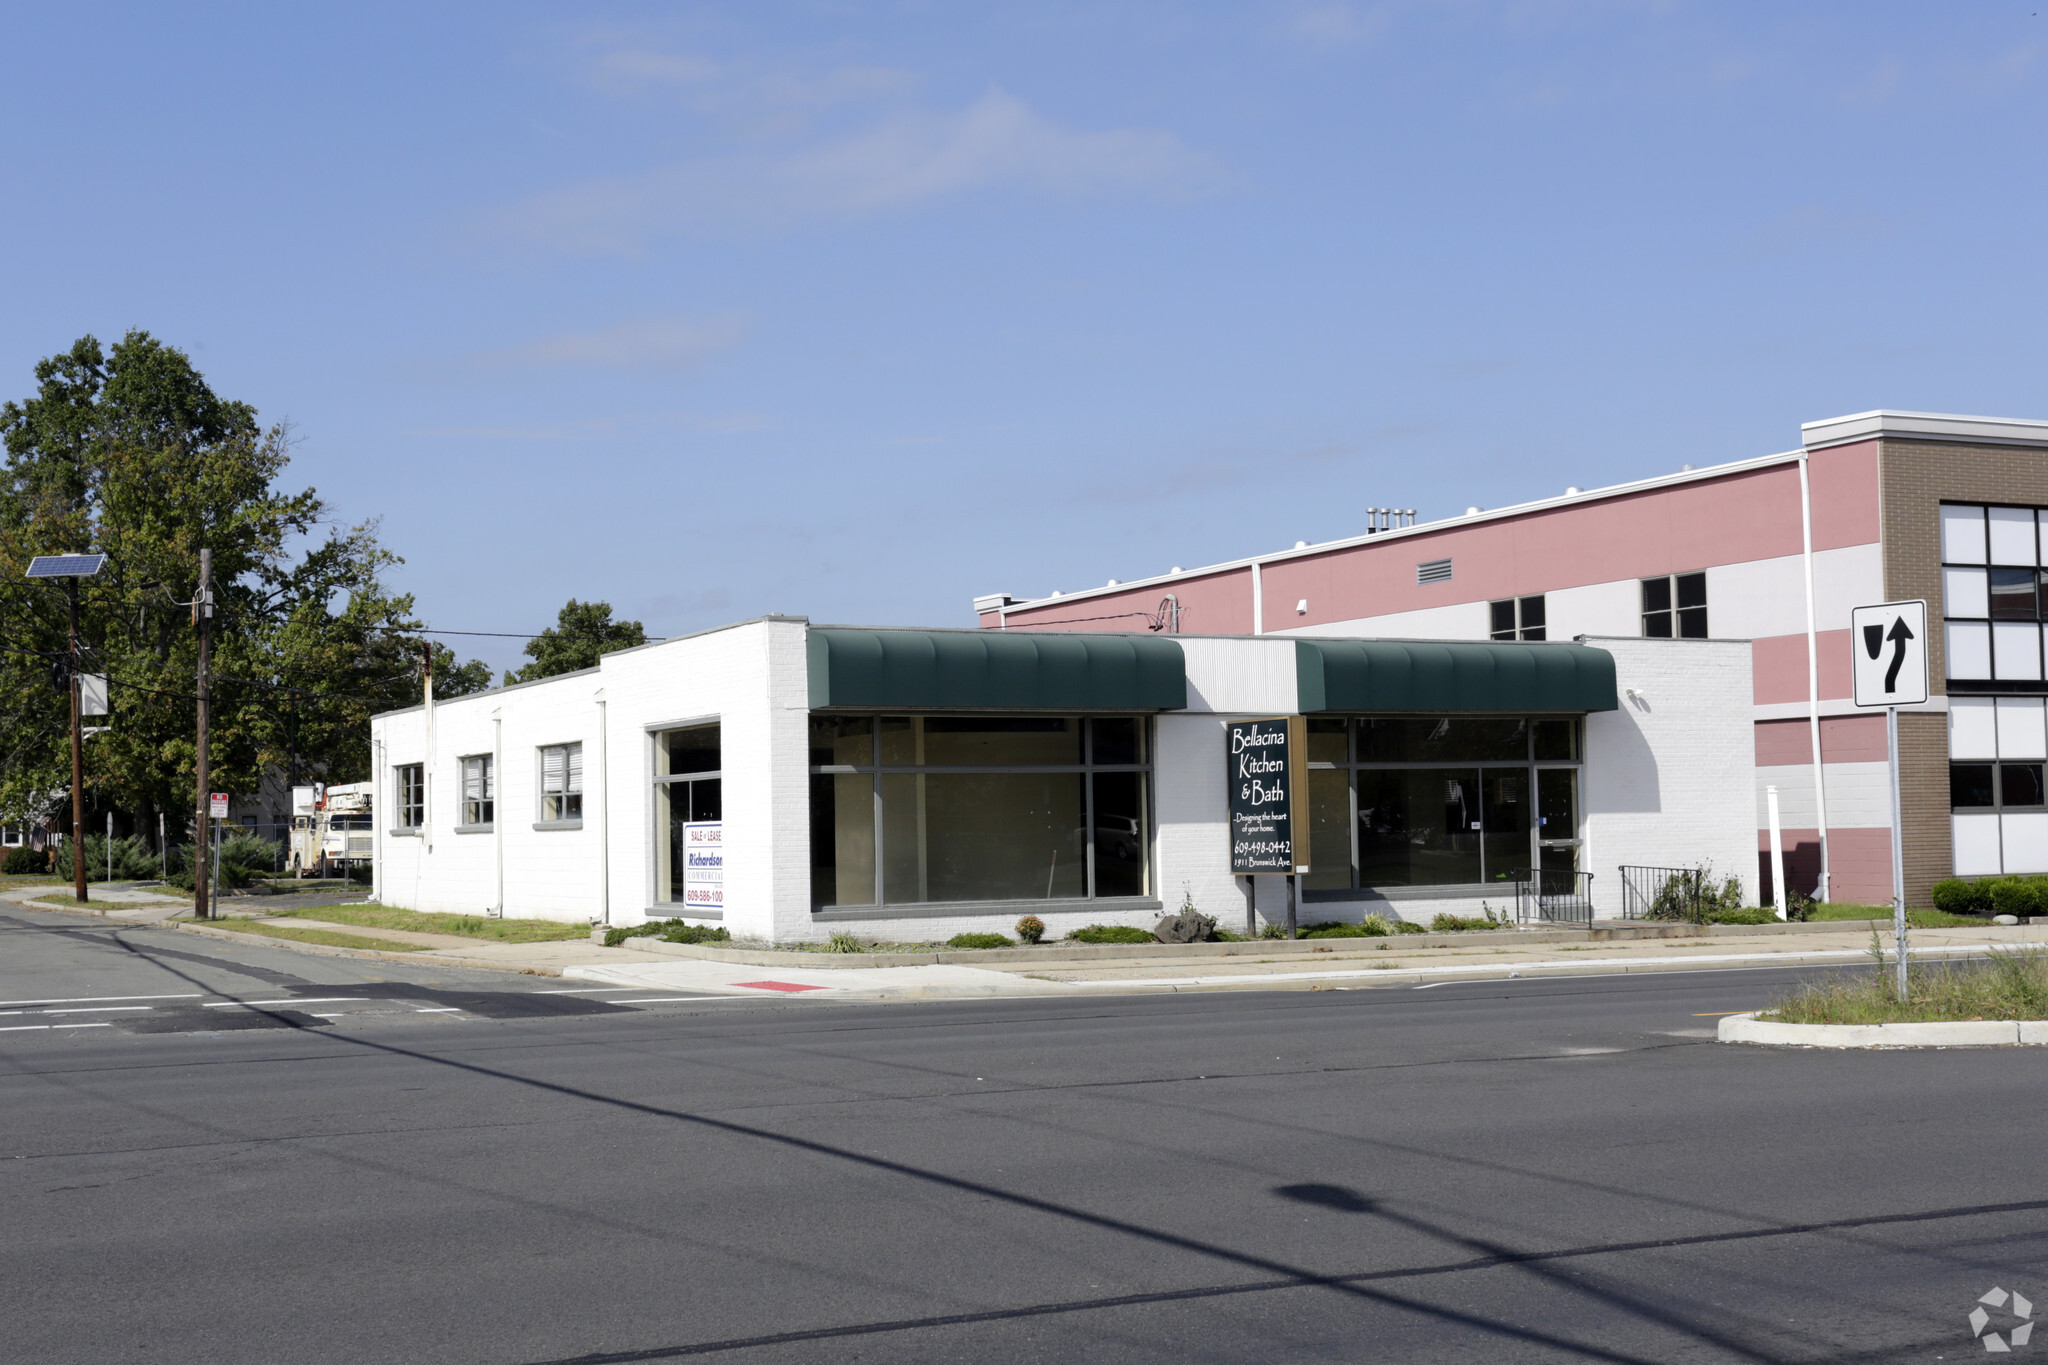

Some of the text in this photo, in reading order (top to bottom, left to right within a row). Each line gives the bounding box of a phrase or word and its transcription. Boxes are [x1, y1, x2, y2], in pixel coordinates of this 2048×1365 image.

[1232, 724, 1284, 753] Bellacina
[1239, 751, 1283, 778] Kitchen
[1241, 779, 1283, 805] & Bath
[1261, 811, 1270, 820] the
[1271, 811, 1287, 820] heart
[691, 831, 703, 841] SALE
[707, 830, 721, 841] LEASE
[1241, 823, 1248, 832] of
[1248, 826, 1260, 835] your
[1234, 840, 1291, 856] 609-498-0442
[1234, 856, 1292, 868] 1911 Brunswick Ave.
